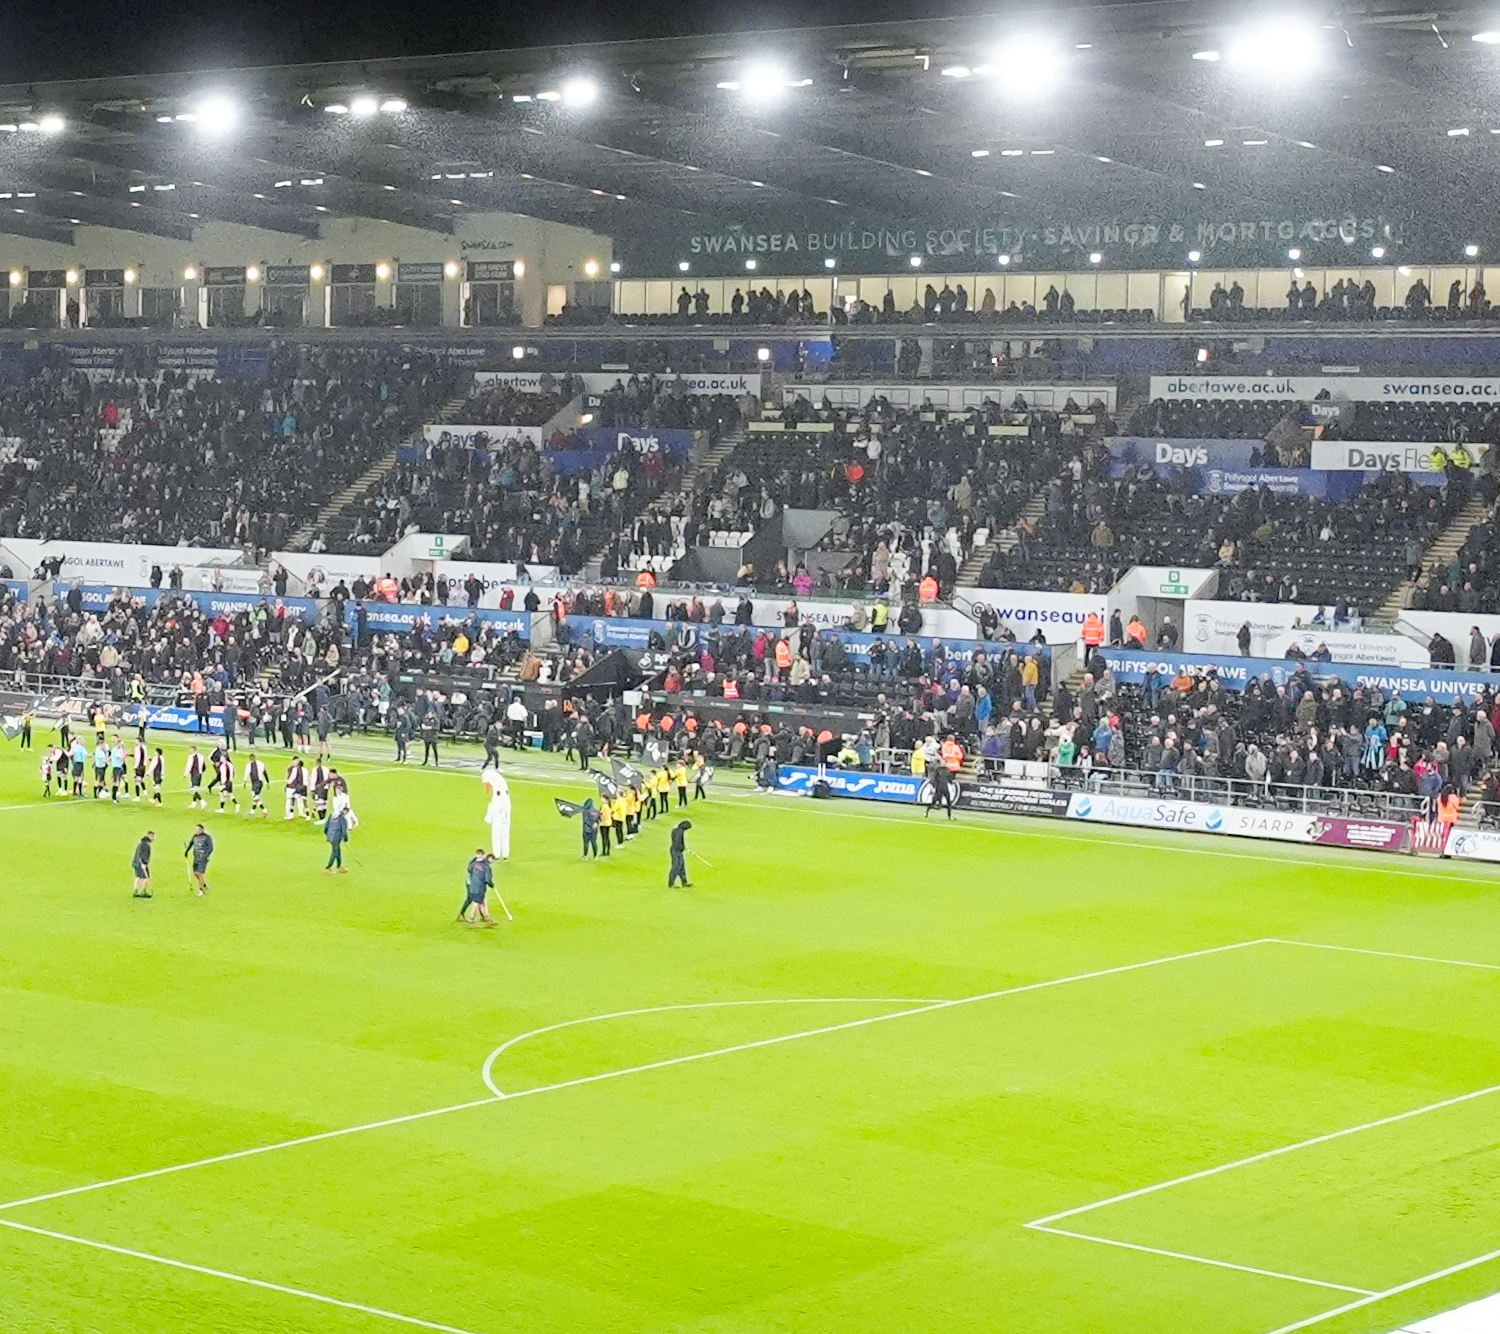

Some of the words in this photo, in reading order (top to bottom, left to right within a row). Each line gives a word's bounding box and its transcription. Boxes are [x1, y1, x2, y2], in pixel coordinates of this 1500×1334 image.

[690, 233, 799, 253] SWANSEA
[807, 230, 917, 251] BUILDING
[925, 227, 1028, 249] SOCIETY
[1167, 378, 1296, 395] abertawe.ac.uk
[85, 556, 126, 570] ABERTAWE
[971, 601, 1105, 624] @wanseaui
[1356, 675, 1427, 693] SWANSEA
[874, 780, 916, 796] joma
[1101, 799, 1197, 826] AquaSafe
[1239, 815, 1295, 833] SIARP
